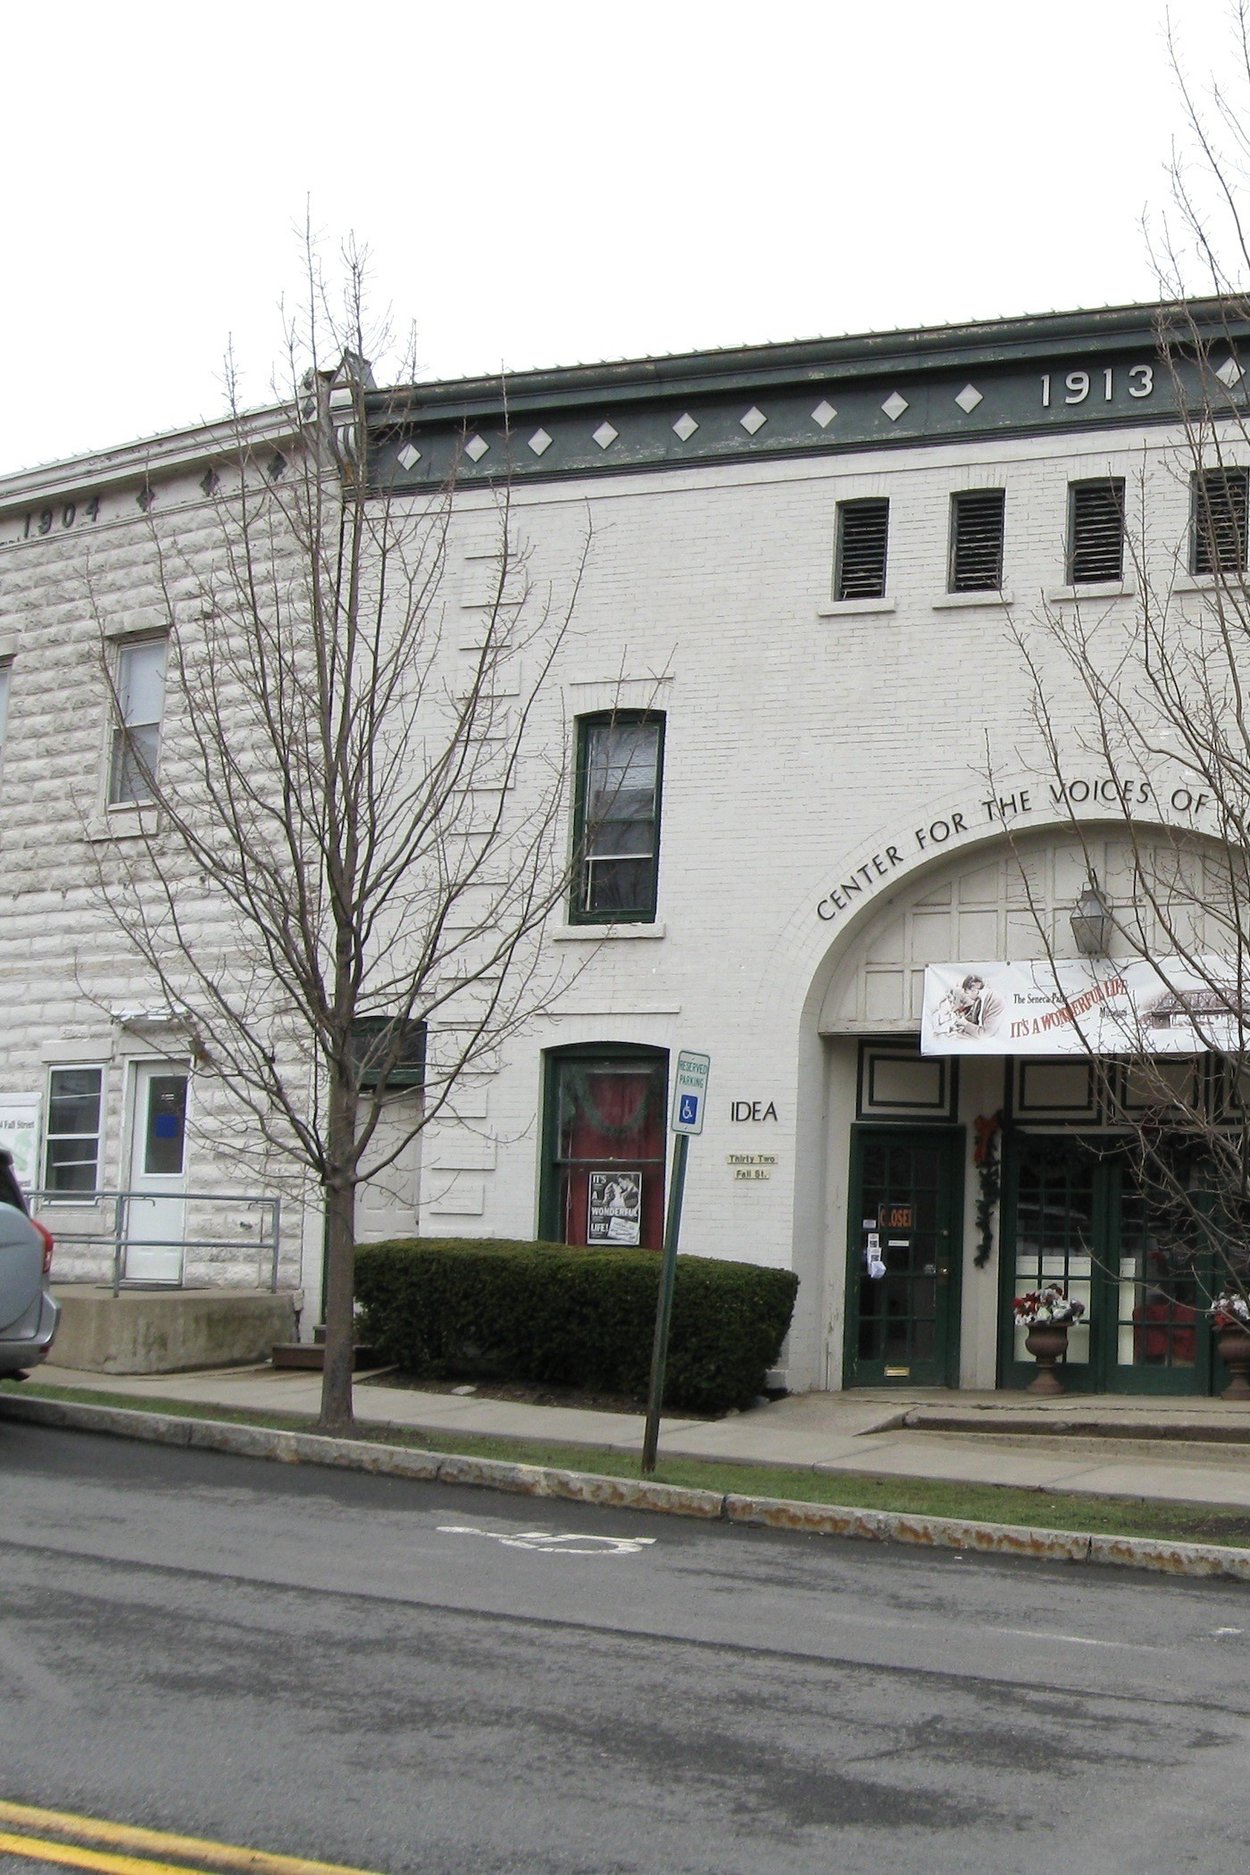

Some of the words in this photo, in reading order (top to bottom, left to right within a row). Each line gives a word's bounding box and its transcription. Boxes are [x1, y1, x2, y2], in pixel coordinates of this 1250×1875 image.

[1040, 364, 1153, 407] 1913
[23, 496, 99, 539] 1904
[816, 845, 904, 921] CENTER
[914, 812, 968, 850] FOR
[981, 789, 1032, 821] THE
[1049, 779, 1151, 804] VOICES
[1170, 788, 1210, 814] OF
[1013, 993, 1026, 1004] The
[1010, 1018, 1030, 1038] IT'S
[1032, 1018, 1041, 1034] A
[679, 1060, 708, 1075] RESERVED
[679, 1074, 704, 1088] PARKING
[731, 1101, 778, 1122] IDEA
[729, 1154, 755, 1164] Thirty
[757, 1154, 775, 1164] Two
[592, 1175, 607, 1184] IT'S
[736, 1169, 752, 1179] Fall
[754, 1169, 768, 1179] St.
[591, 1207, 638, 1216] WONDERFUL
